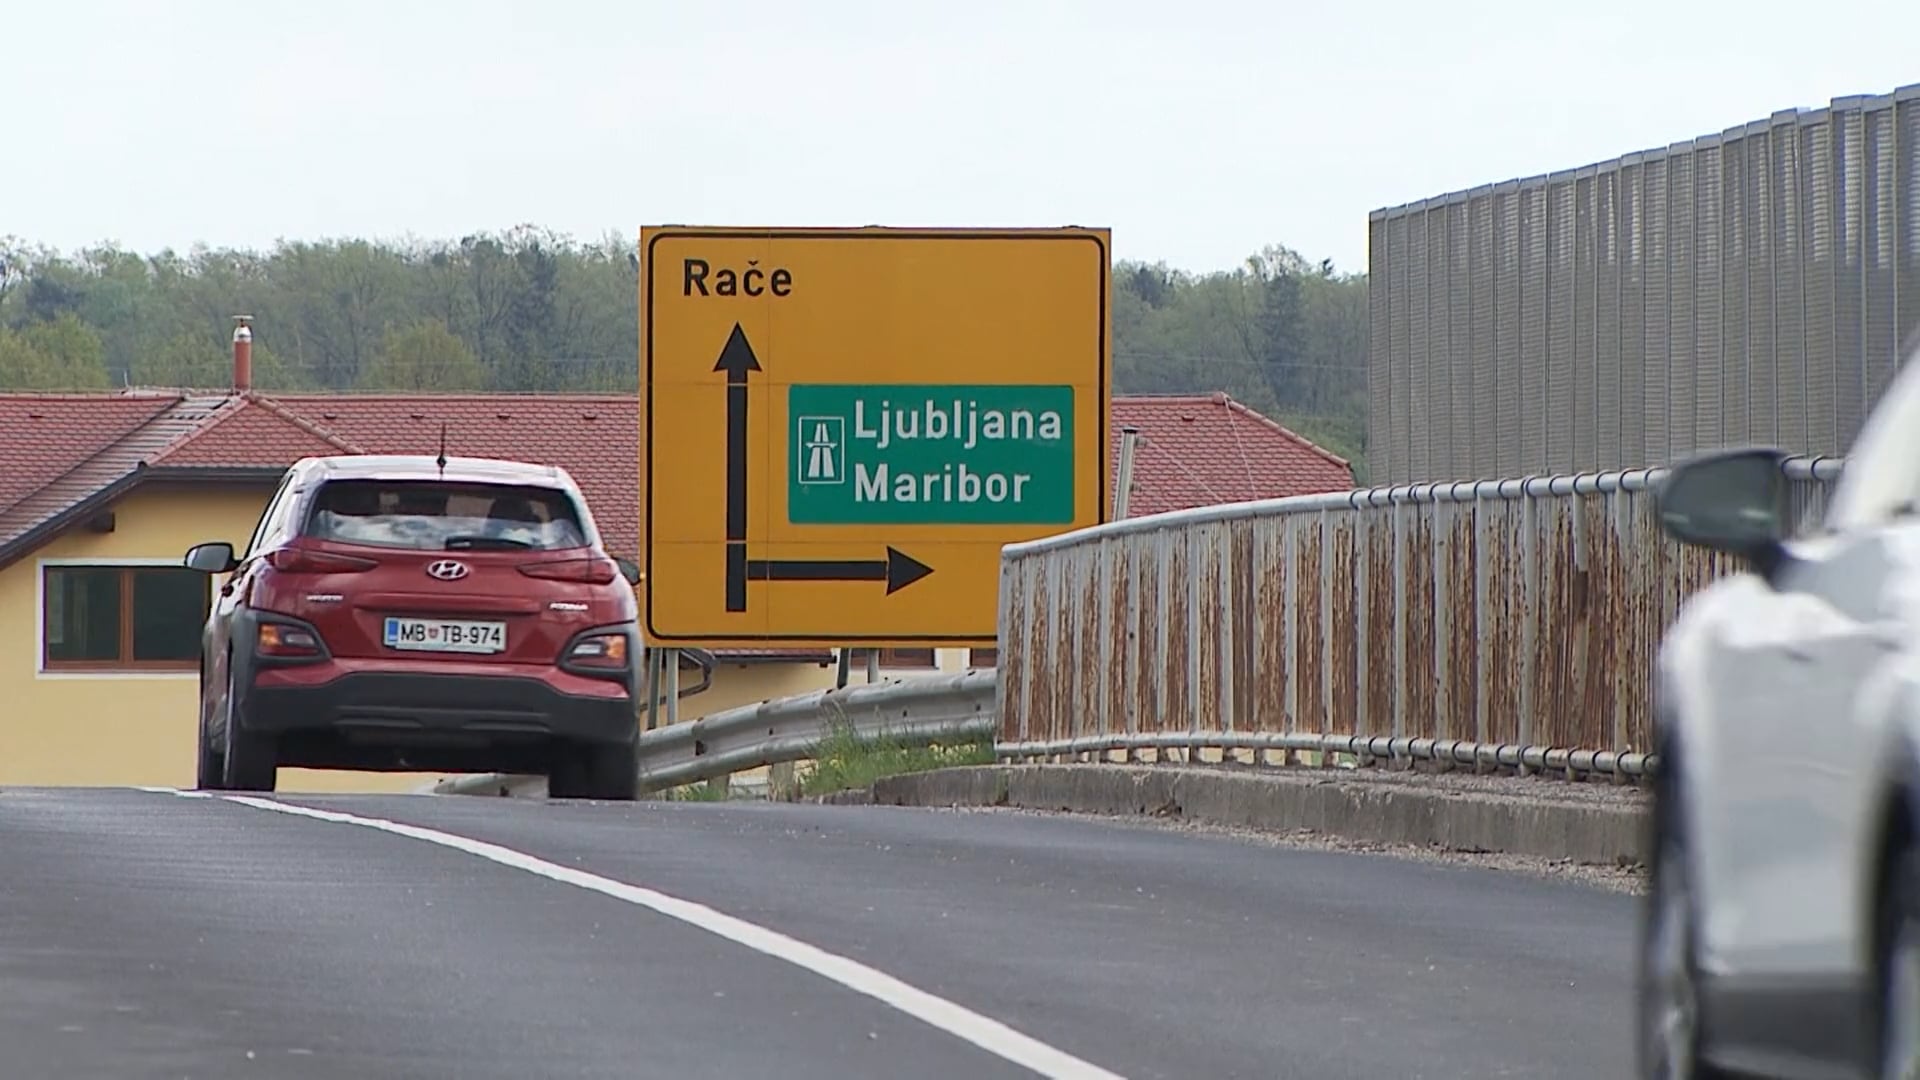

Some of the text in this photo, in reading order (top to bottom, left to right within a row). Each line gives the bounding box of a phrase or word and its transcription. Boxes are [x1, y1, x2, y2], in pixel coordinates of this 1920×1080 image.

[683, 258, 793, 297] Rače
[854, 400, 1062, 449] Ljubljana
[854, 464, 1030, 503] Maribor
[402, 625, 501, 644] MB TB-974
